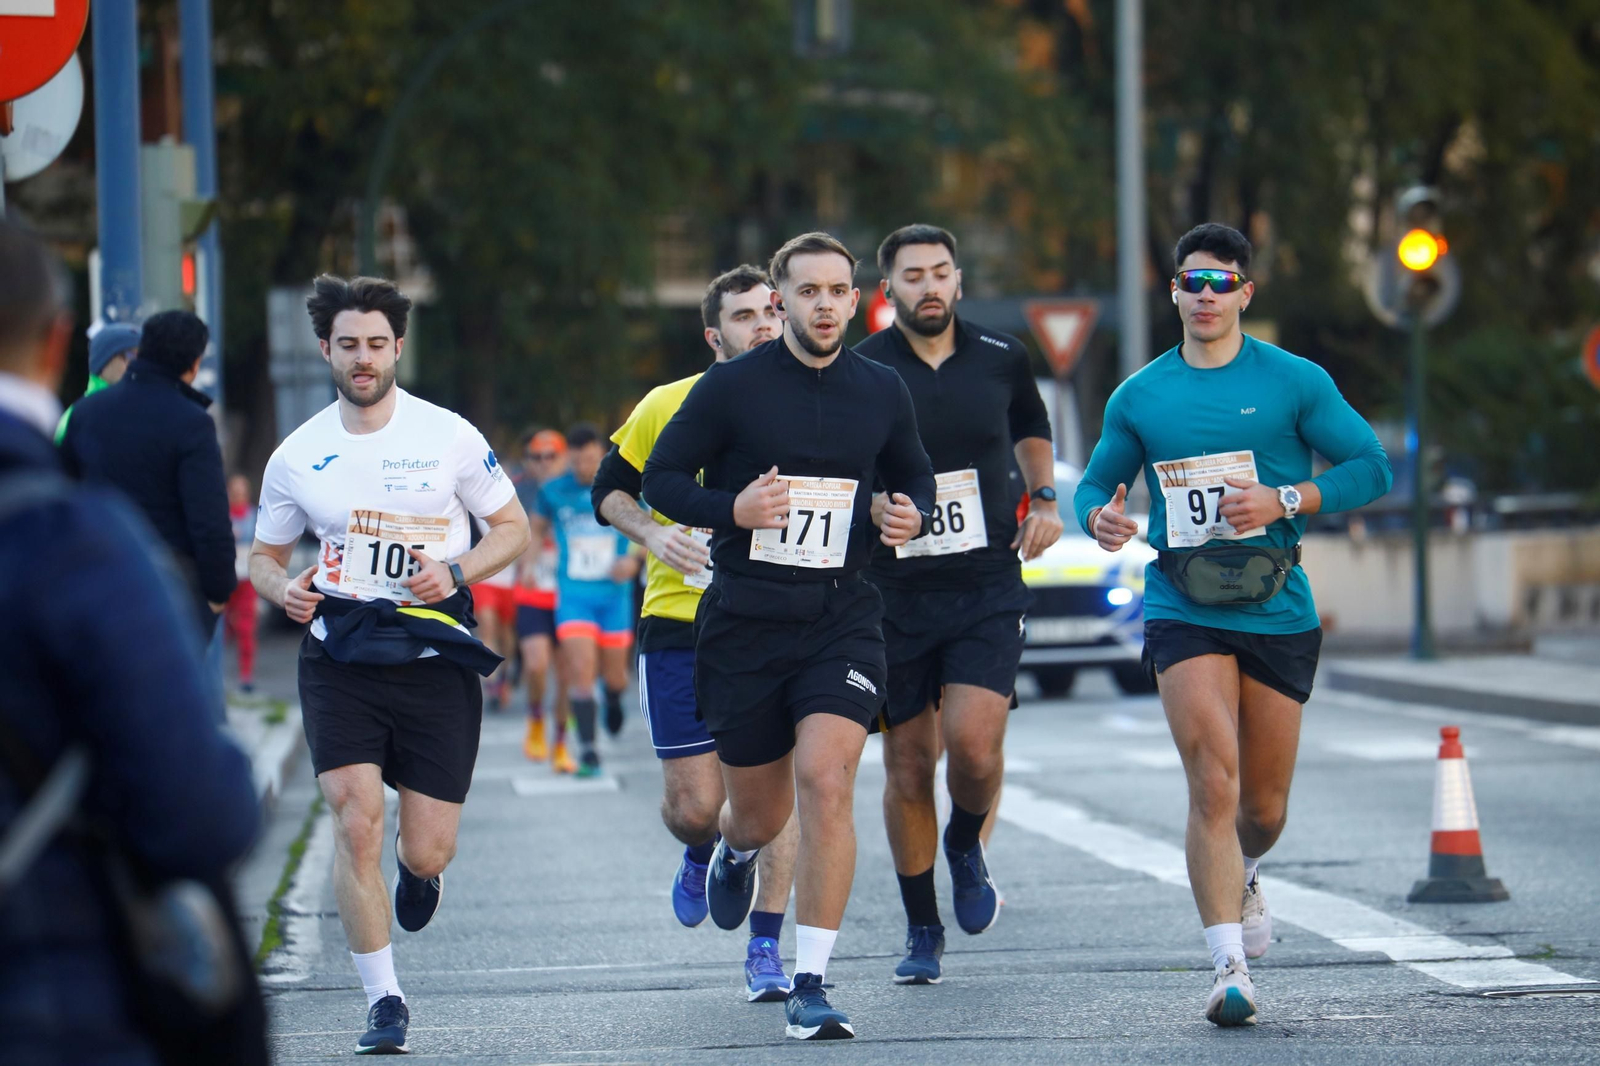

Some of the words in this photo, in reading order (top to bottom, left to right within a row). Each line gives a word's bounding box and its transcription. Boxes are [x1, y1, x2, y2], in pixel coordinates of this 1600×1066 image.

[1241, 407, 1256, 415] MP
[382, 459, 440, 470] ProFuturo
[1160, 463, 1188, 487] XLI
[1187, 486, 1225, 526] 97
[351, 510, 382, 537] XLI
